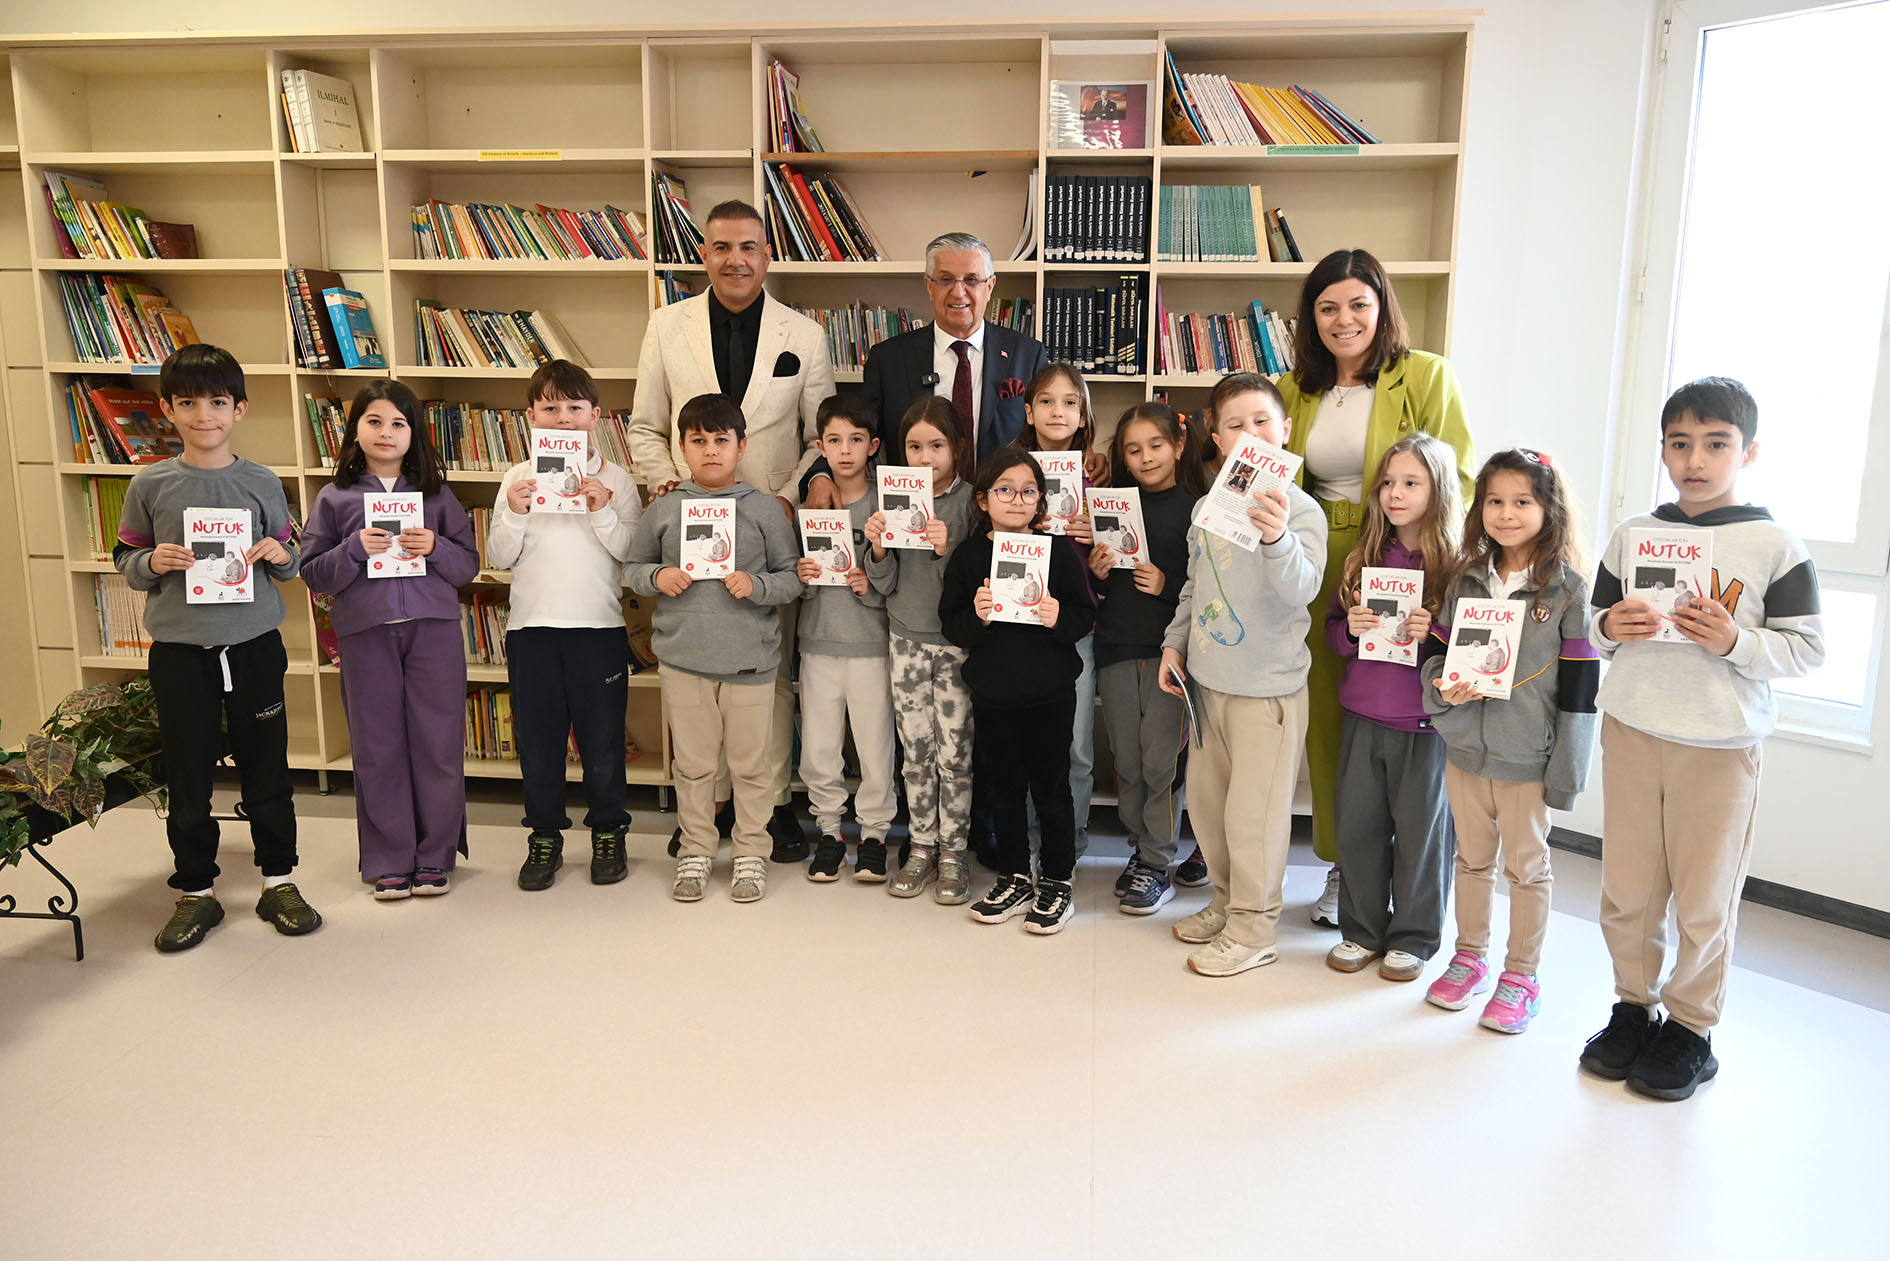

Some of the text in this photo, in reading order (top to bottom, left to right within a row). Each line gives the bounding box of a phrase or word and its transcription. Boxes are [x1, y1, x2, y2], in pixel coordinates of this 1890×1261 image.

[519, 322, 536, 345] HAYDER
[539, 437, 581, 452] NUTUK
[1240, 446, 1289, 478] NUTUK
[884, 475, 925, 489] NUTUK
[373, 501, 417, 513] NUTUK
[689, 506, 728, 518] NUTUK
[1093, 498, 1130, 512] NUTUK
[193, 520, 244, 534] NUTUK
[806, 519, 845, 531] NUTUK
[1001, 540, 1045, 558] NUTUK
[1638, 541, 1701, 560] NUTUK
[1370, 577, 1416, 595] NUTUK
[1464, 606, 1515, 623] NUTUK
